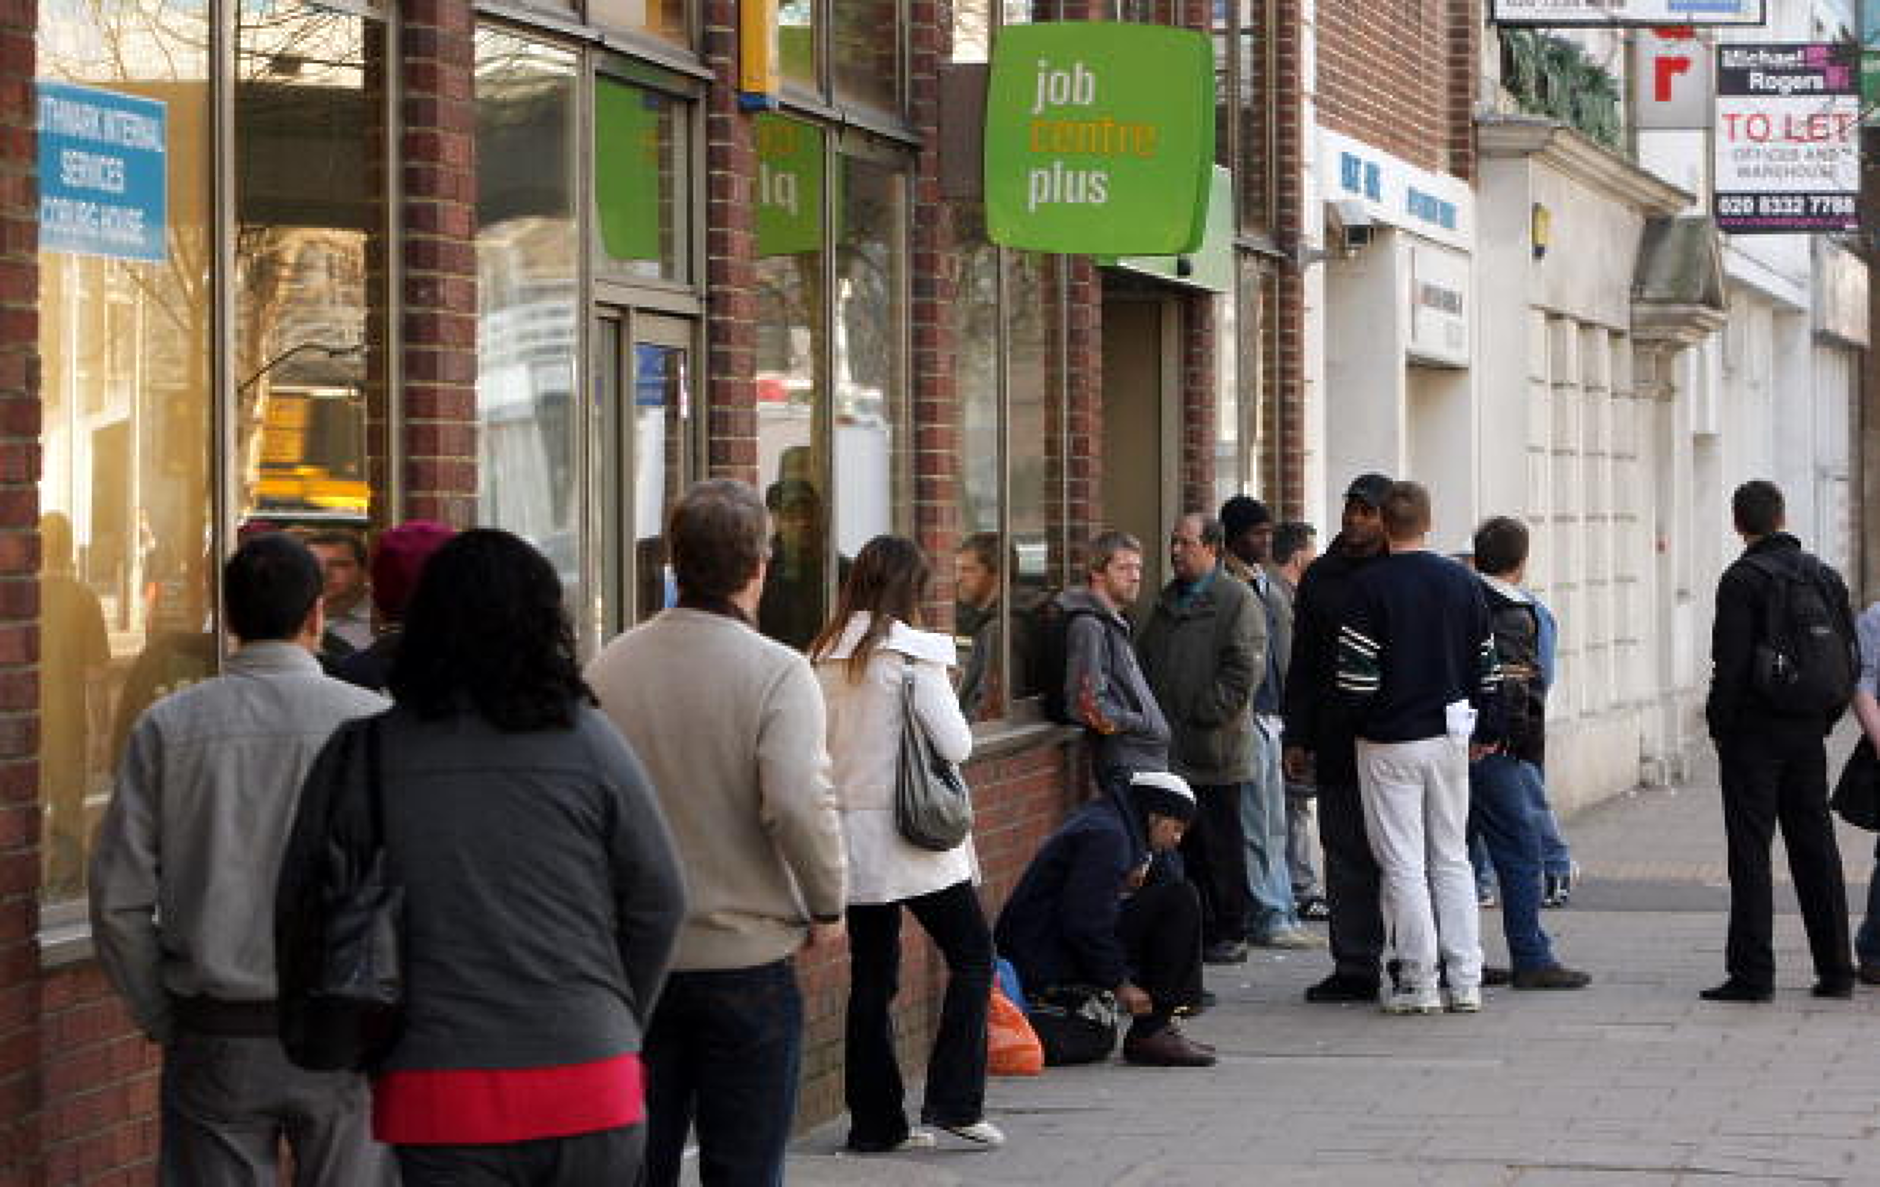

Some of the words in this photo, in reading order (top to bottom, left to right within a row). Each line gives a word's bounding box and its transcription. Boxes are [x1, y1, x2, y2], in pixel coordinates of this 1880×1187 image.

[1722, 49, 1805, 67] Michael
[1031, 58, 1097, 115] job
[1749, 72, 1824, 95] Rogers
[1029, 117, 1158, 157] centre
[1721, 112, 1771, 143] TO
[1784, 112, 1855, 143] LET
[1027, 160, 1109, 213] plus
[1718, 196, 1754, 215] 020
